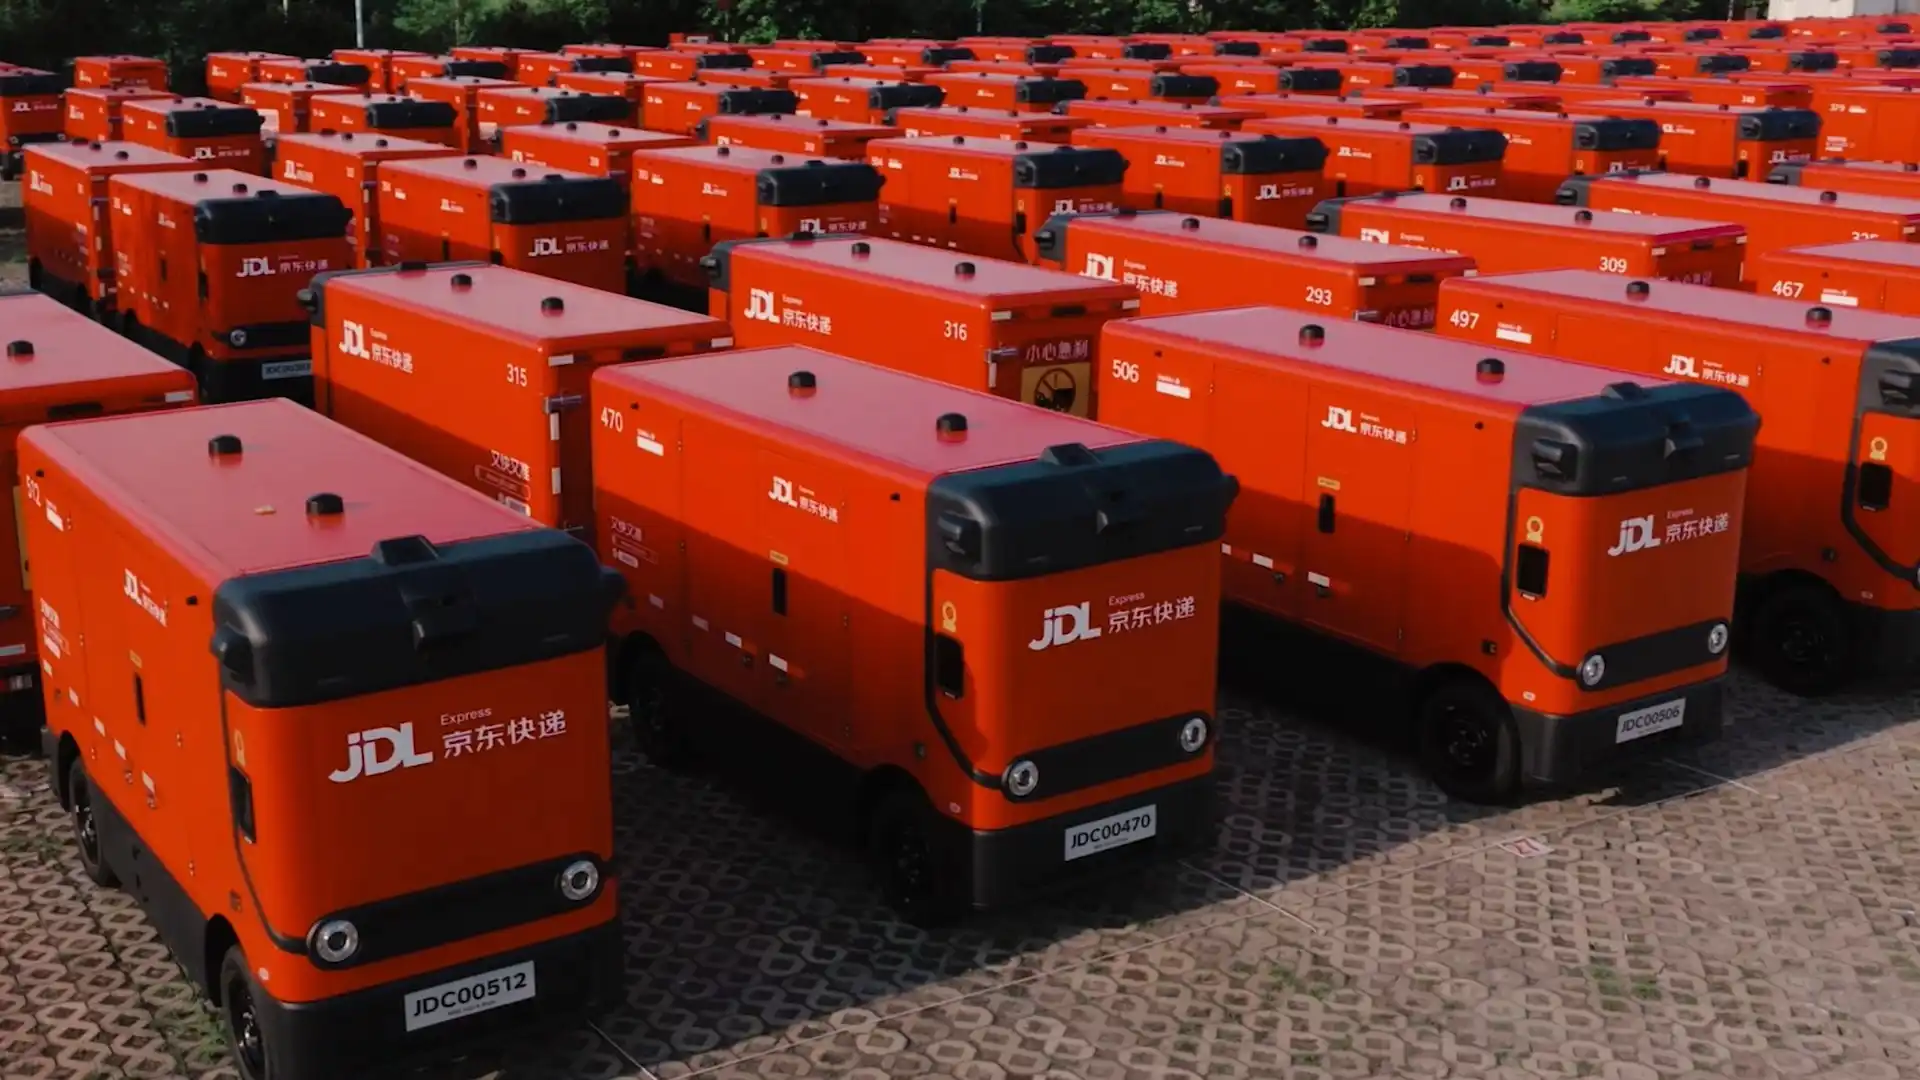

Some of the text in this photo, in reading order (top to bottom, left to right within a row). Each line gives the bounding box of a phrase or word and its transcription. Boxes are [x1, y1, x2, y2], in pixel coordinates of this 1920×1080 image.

[527, 237, 563, 257] JDL
[236, 257, 276, 278] JDL
[1079, 252, 1122, 284] JDL
[1599, 256, 1628, 274] 309
[1305, 285, 1332, 306] 293
[1771, 279, 1805, 299] 467
[743, 287, 780, 324] JDL
[943, 320, 968, 342] 316
[1449, 308, 1480, 330] 497
[338, 318, 370, 361] JDL
[506, 363, 528, 387] 315
[1111, 358, 1140, 384] 506
[1661, 353, 1700, 379] JDL
[601, 406, 624, 433] 470
[1320, 405, 1358, 434] JDL
[767, 475, 799, 509] JDL
[1607, 512, 1730, 557] JDL 京东快递
[1108, 591, 1146, 608] Express
[1027, 595, 1196, 652] JDL 京东快递
[440, 706, 493, 727] Express
[1621, 704, 1681, 733] JDC00506
[327, 708, 568, 784] JDL 京东快递
[1070, 814, 1151, 849] JDC00470
[413, 972, 529, 1018] JDC00512
